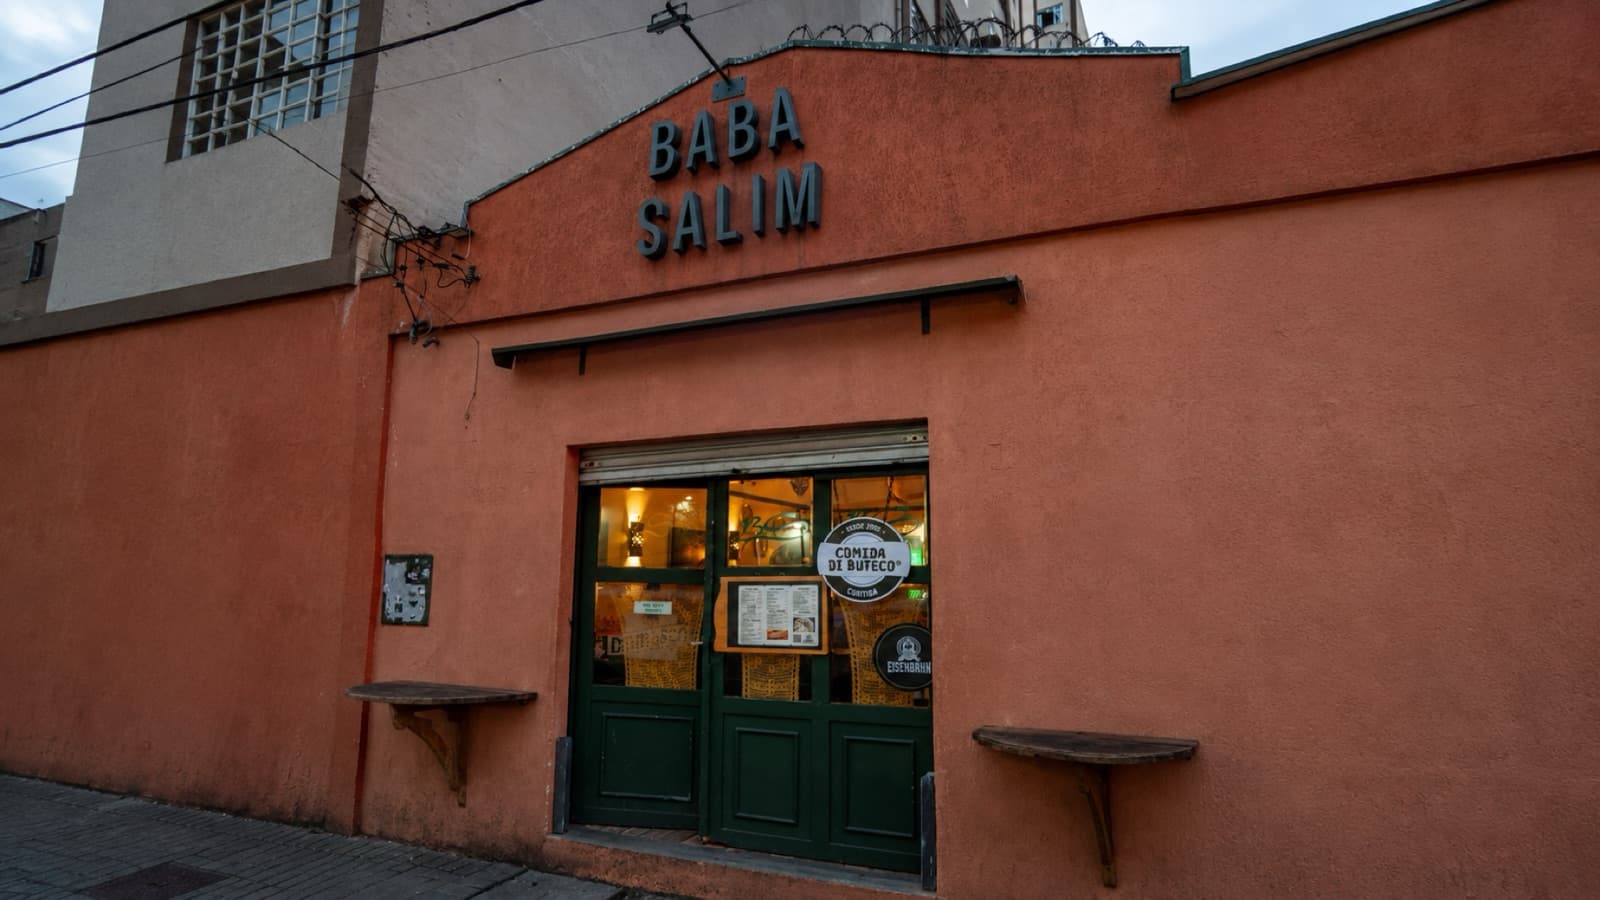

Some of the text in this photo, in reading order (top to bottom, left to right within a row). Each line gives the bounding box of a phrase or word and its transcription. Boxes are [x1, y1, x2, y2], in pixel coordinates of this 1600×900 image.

[649, 86, 804, 181] BABA
[636, 161, 823, 260] SALIM
[835, 547, 886, 559] COMIDA
[828, 560, 842, 571] DI
[887, 661, 931, 674] EISENBAHN
